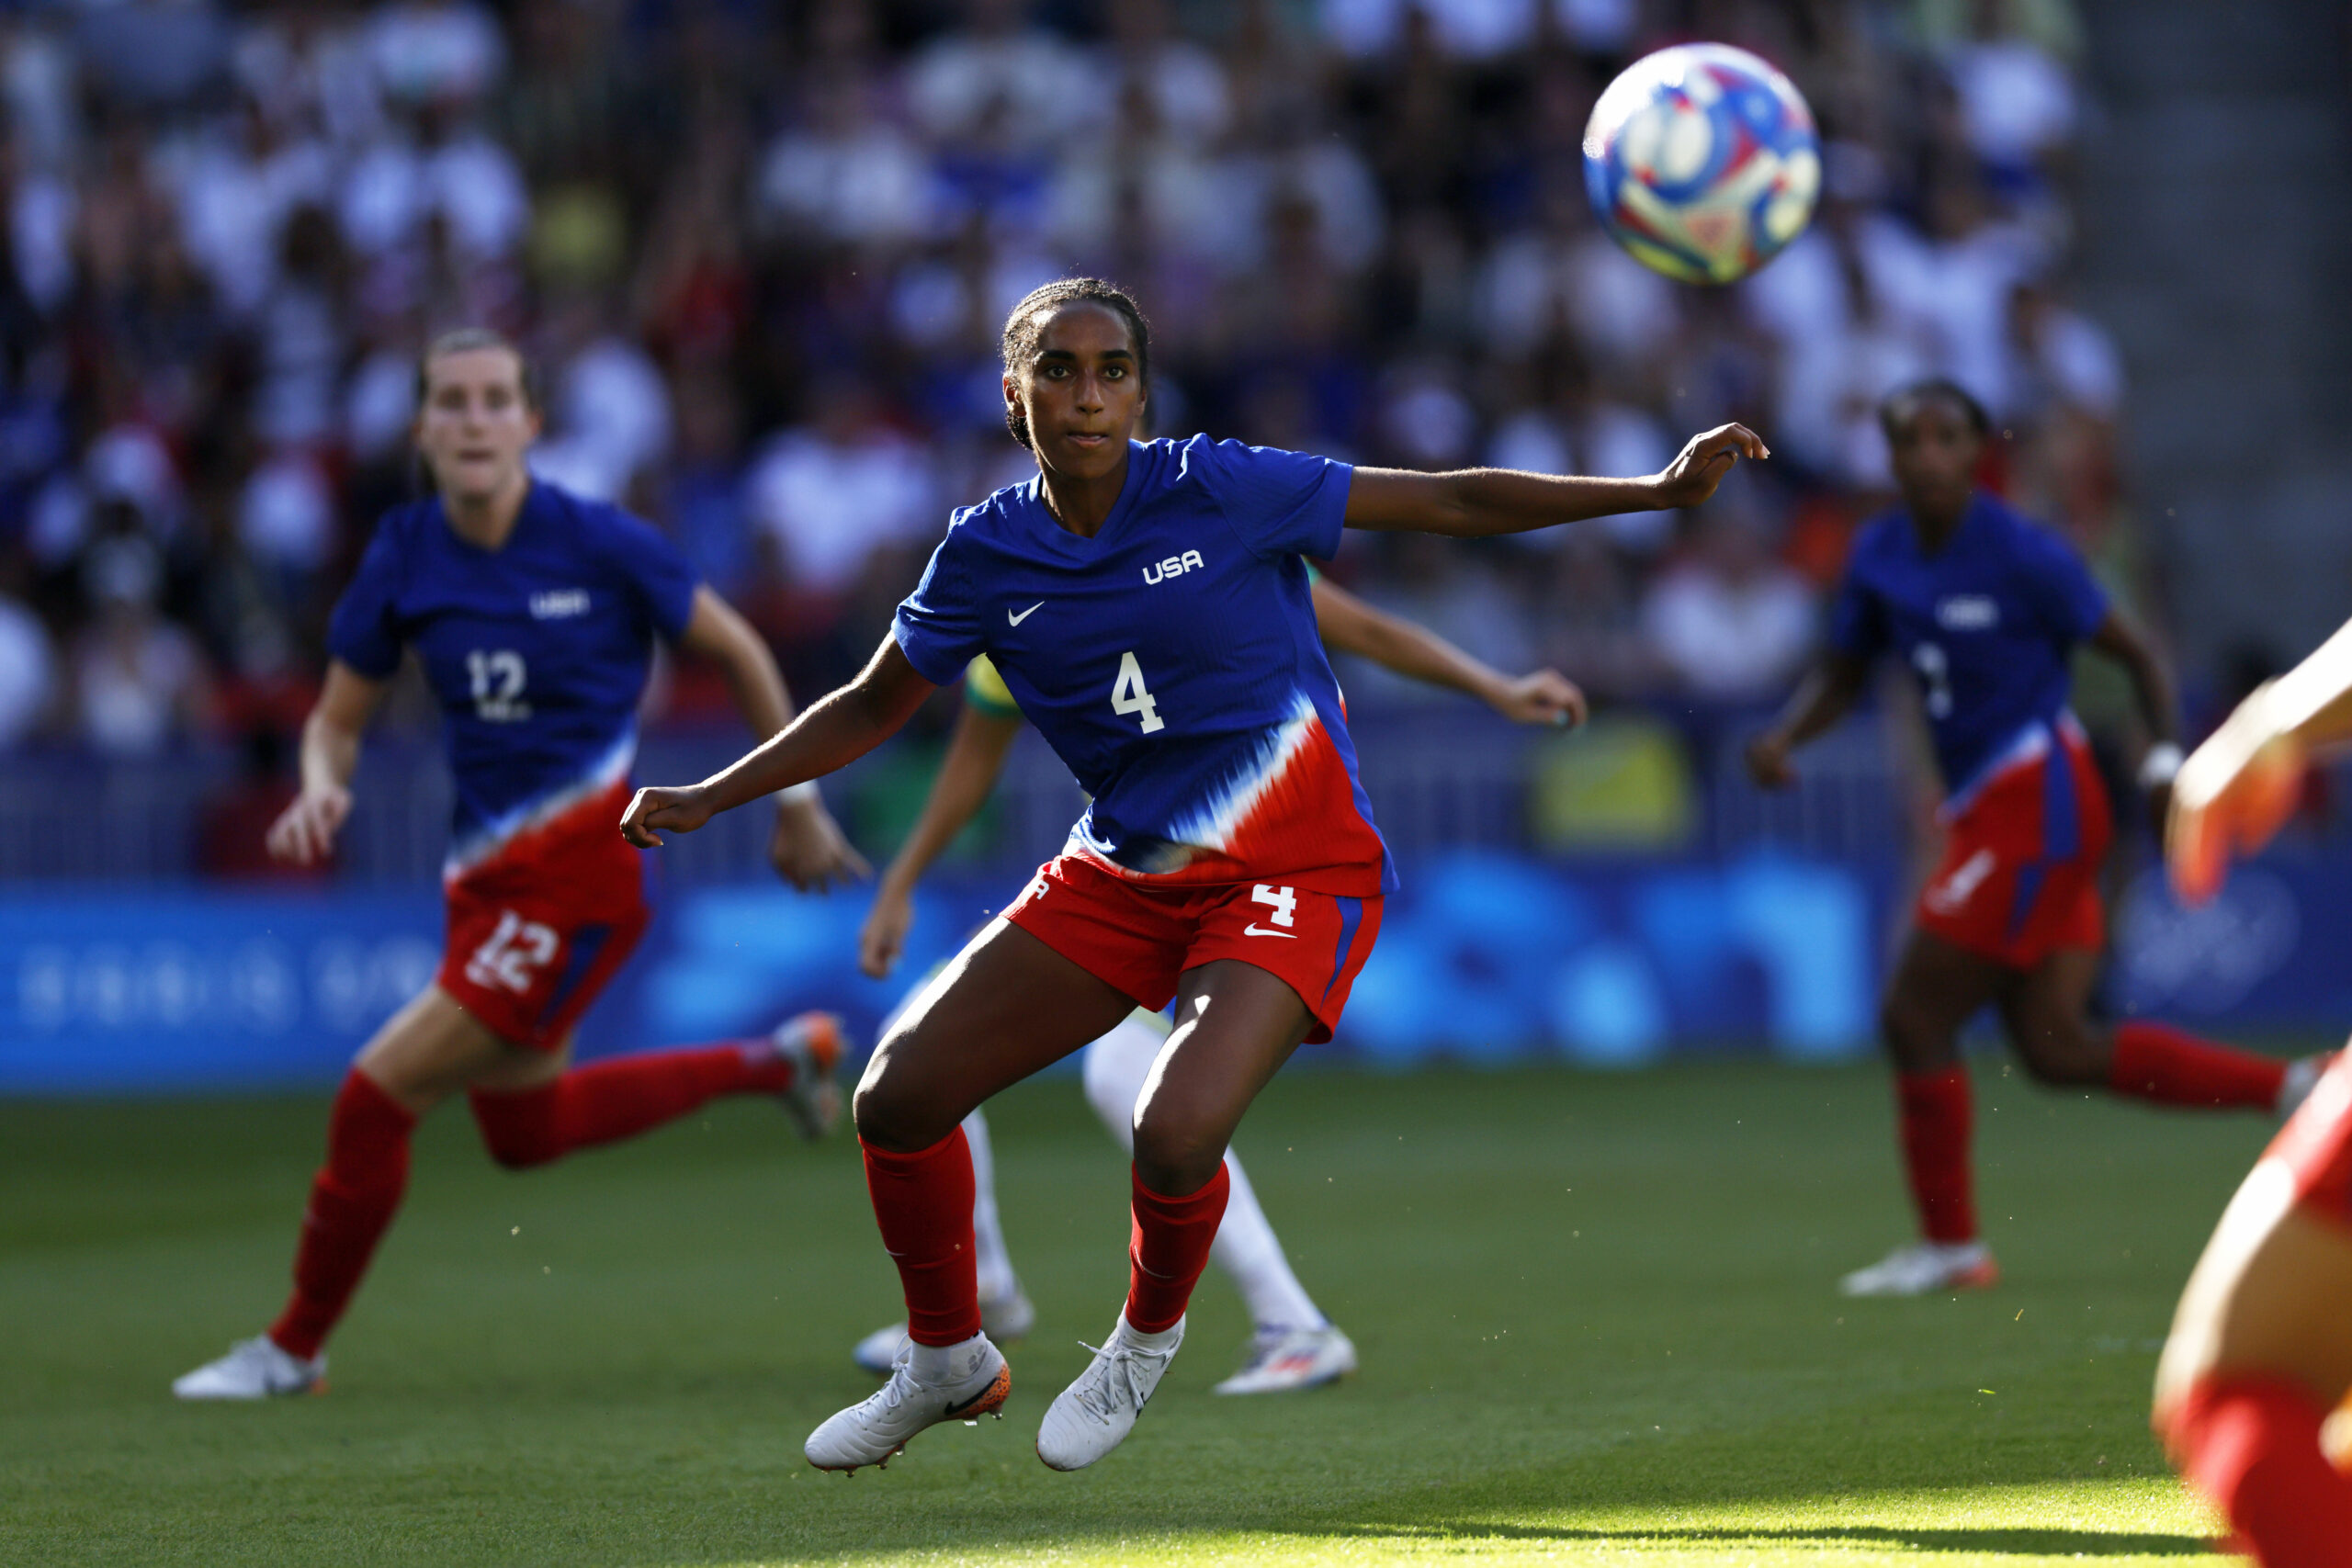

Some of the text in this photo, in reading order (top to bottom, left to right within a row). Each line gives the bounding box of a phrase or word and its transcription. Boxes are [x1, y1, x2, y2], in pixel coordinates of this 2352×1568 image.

[1142, 549, 1204, 585] USA
[467, 648, 533, 724] 12
[1111, 651, 1165, 734] 4
[1251, 884, 1297, 927] 4
[465, 908, 559, 996] 12
